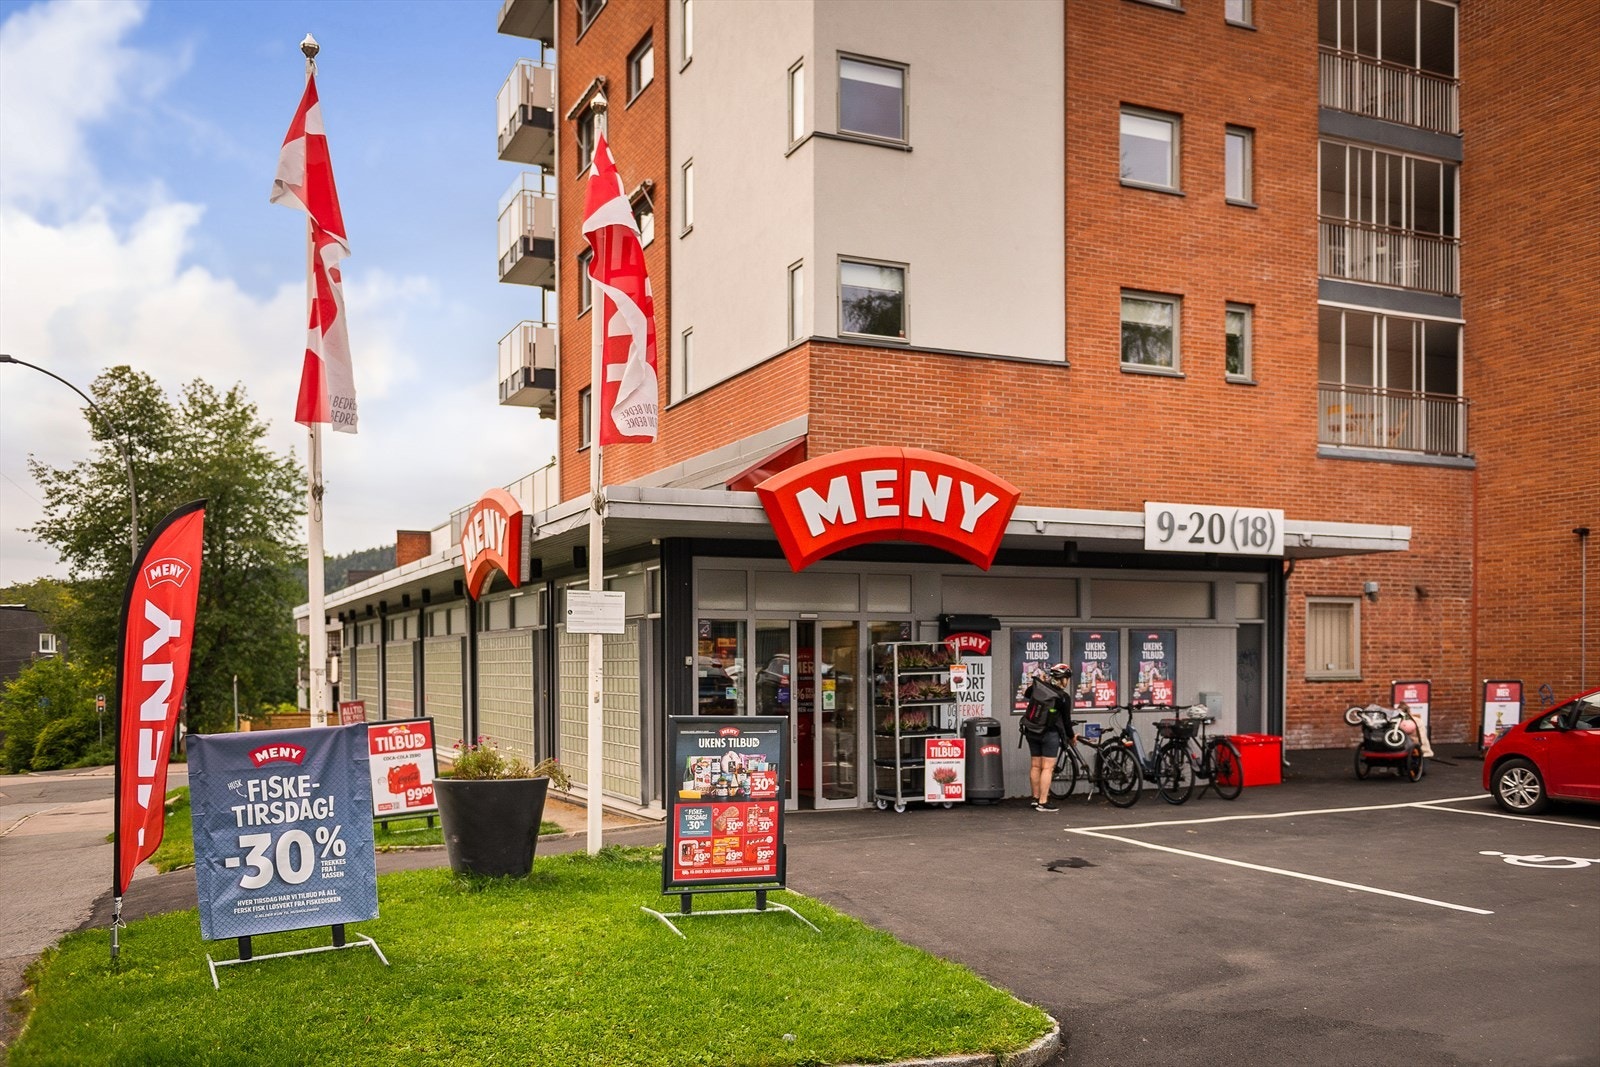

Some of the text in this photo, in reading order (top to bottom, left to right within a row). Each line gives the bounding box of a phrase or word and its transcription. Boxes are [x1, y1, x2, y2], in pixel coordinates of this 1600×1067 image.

[795, 469, 1000, 538] MENY
[1157, 509, 1276, 553] 9-20 (18)
[462, 507, 508, 573] MENY
[149, 566, 185, 580] MENY
[949, 636, 987, 650] MENY
[1026, 642, 1048, 651] UKENS
[1085, 642, 1106, 651] UKENS
[1143, 642, 1163, 651] UKENS
[1025, 651, 1050, 660] TILBUD
[1084, 651, 1107, 660] TILBUD
[1142, 651, 1165, 660] TILBUD
[375, 733, 426, 752] TILBUD
[698, 737, 760, 748] UKENS TILBUD
[254, 747, 302, 763] MENY
[930, 746, 961, 757] TILBUD
[247, 775, 320, 802] FISKE-
[231, 796, 335, 828] TIRSDAG!
[254, 896, 278, 904] TIRSDAG
[278, 894, 291, 902] HAR
[298, 891, 318, 899] TILBUD
[318, 889, 327, 897] PÅ
[269, 901, 294, 910] LØSVEKT
[305, 896, 342, 905] FISKEDISKEN
